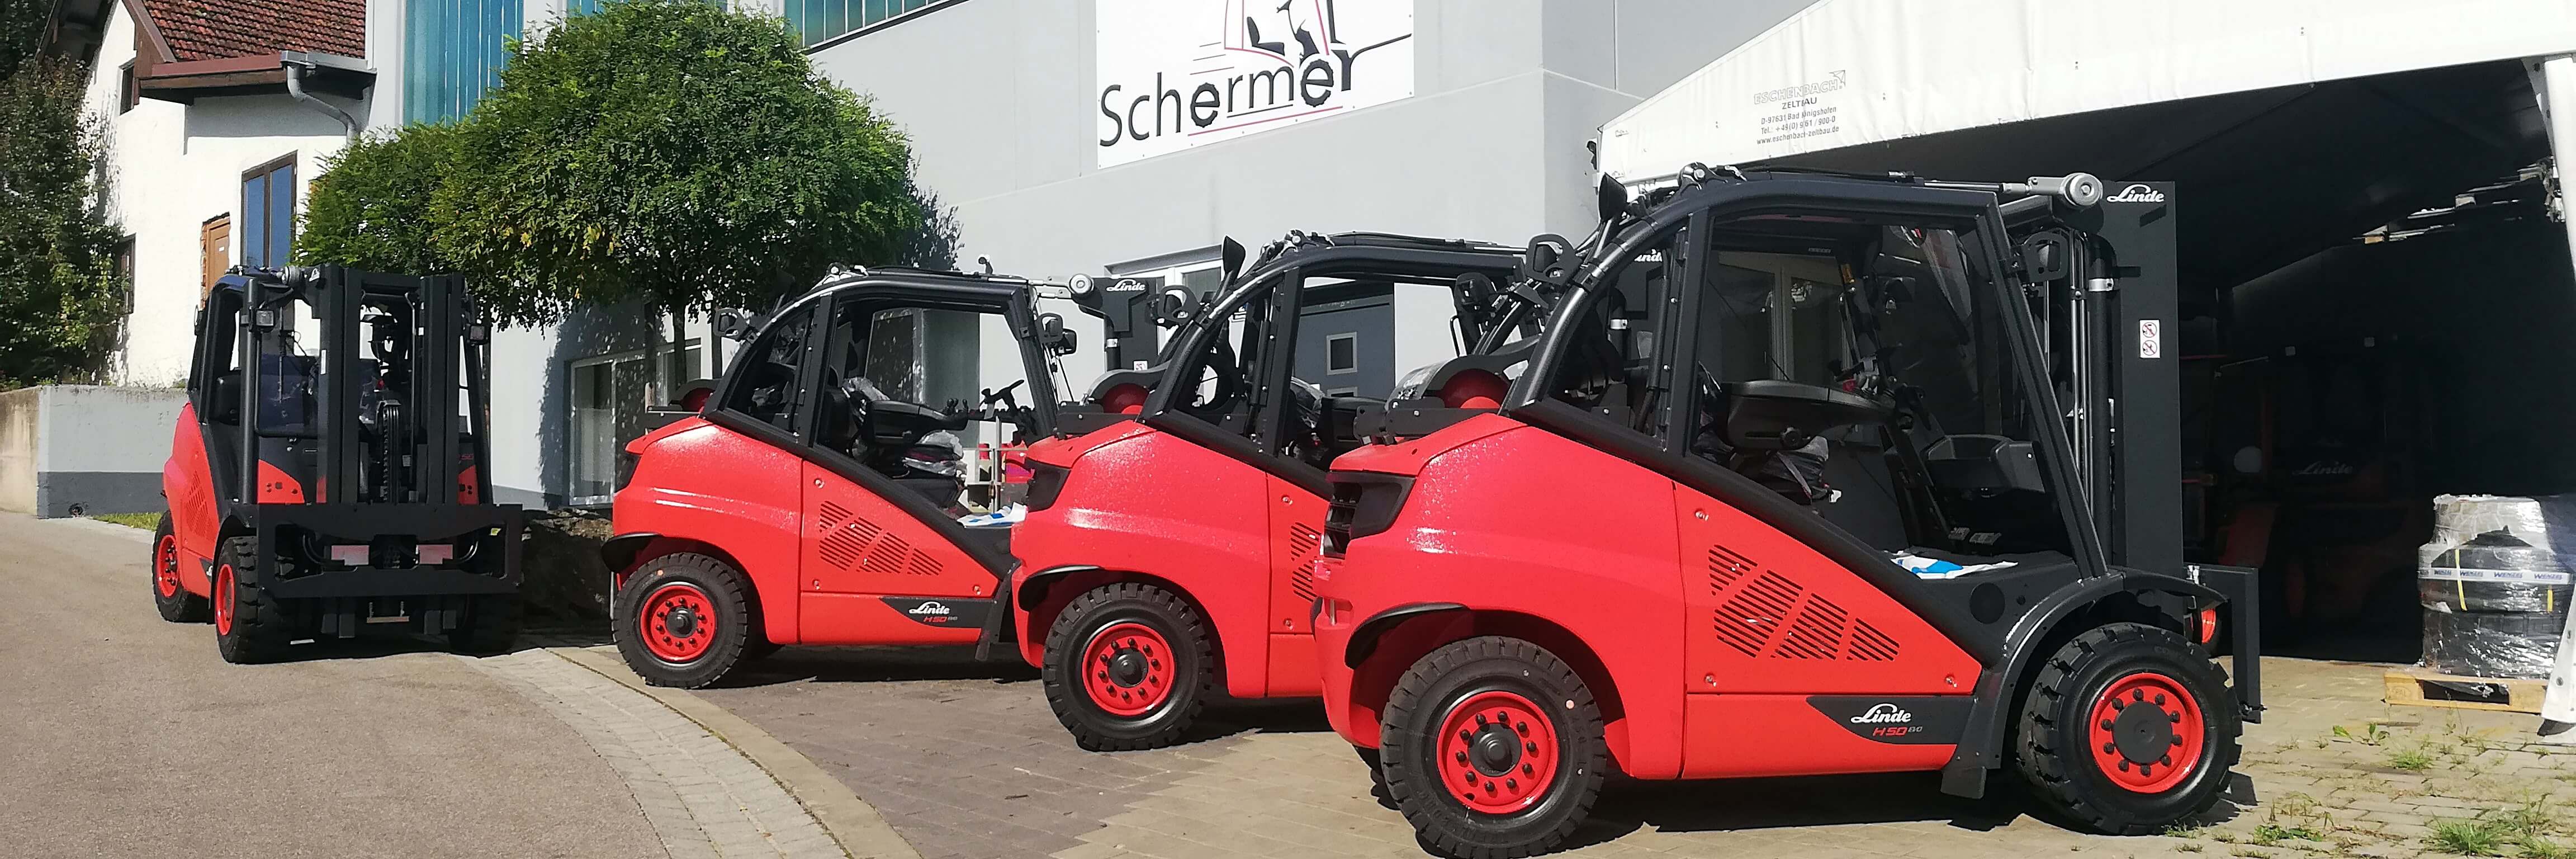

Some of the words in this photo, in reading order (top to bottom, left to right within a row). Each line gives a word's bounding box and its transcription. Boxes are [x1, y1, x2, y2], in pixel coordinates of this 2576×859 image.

[1100, 35, 1412, 147] Schermer
[1782, 97, 1817, 110] ZELTBAU
[1788, 112, 1800, 120] Bad
[1802, 106, 1836, 118] nigshofen
[2107, 184, 2165, 202] Linde
[1106, 279, 1145, 291] Linde
[909, 601, 950, 614] Linde
[1851, 703, 1911, 723] Linde
